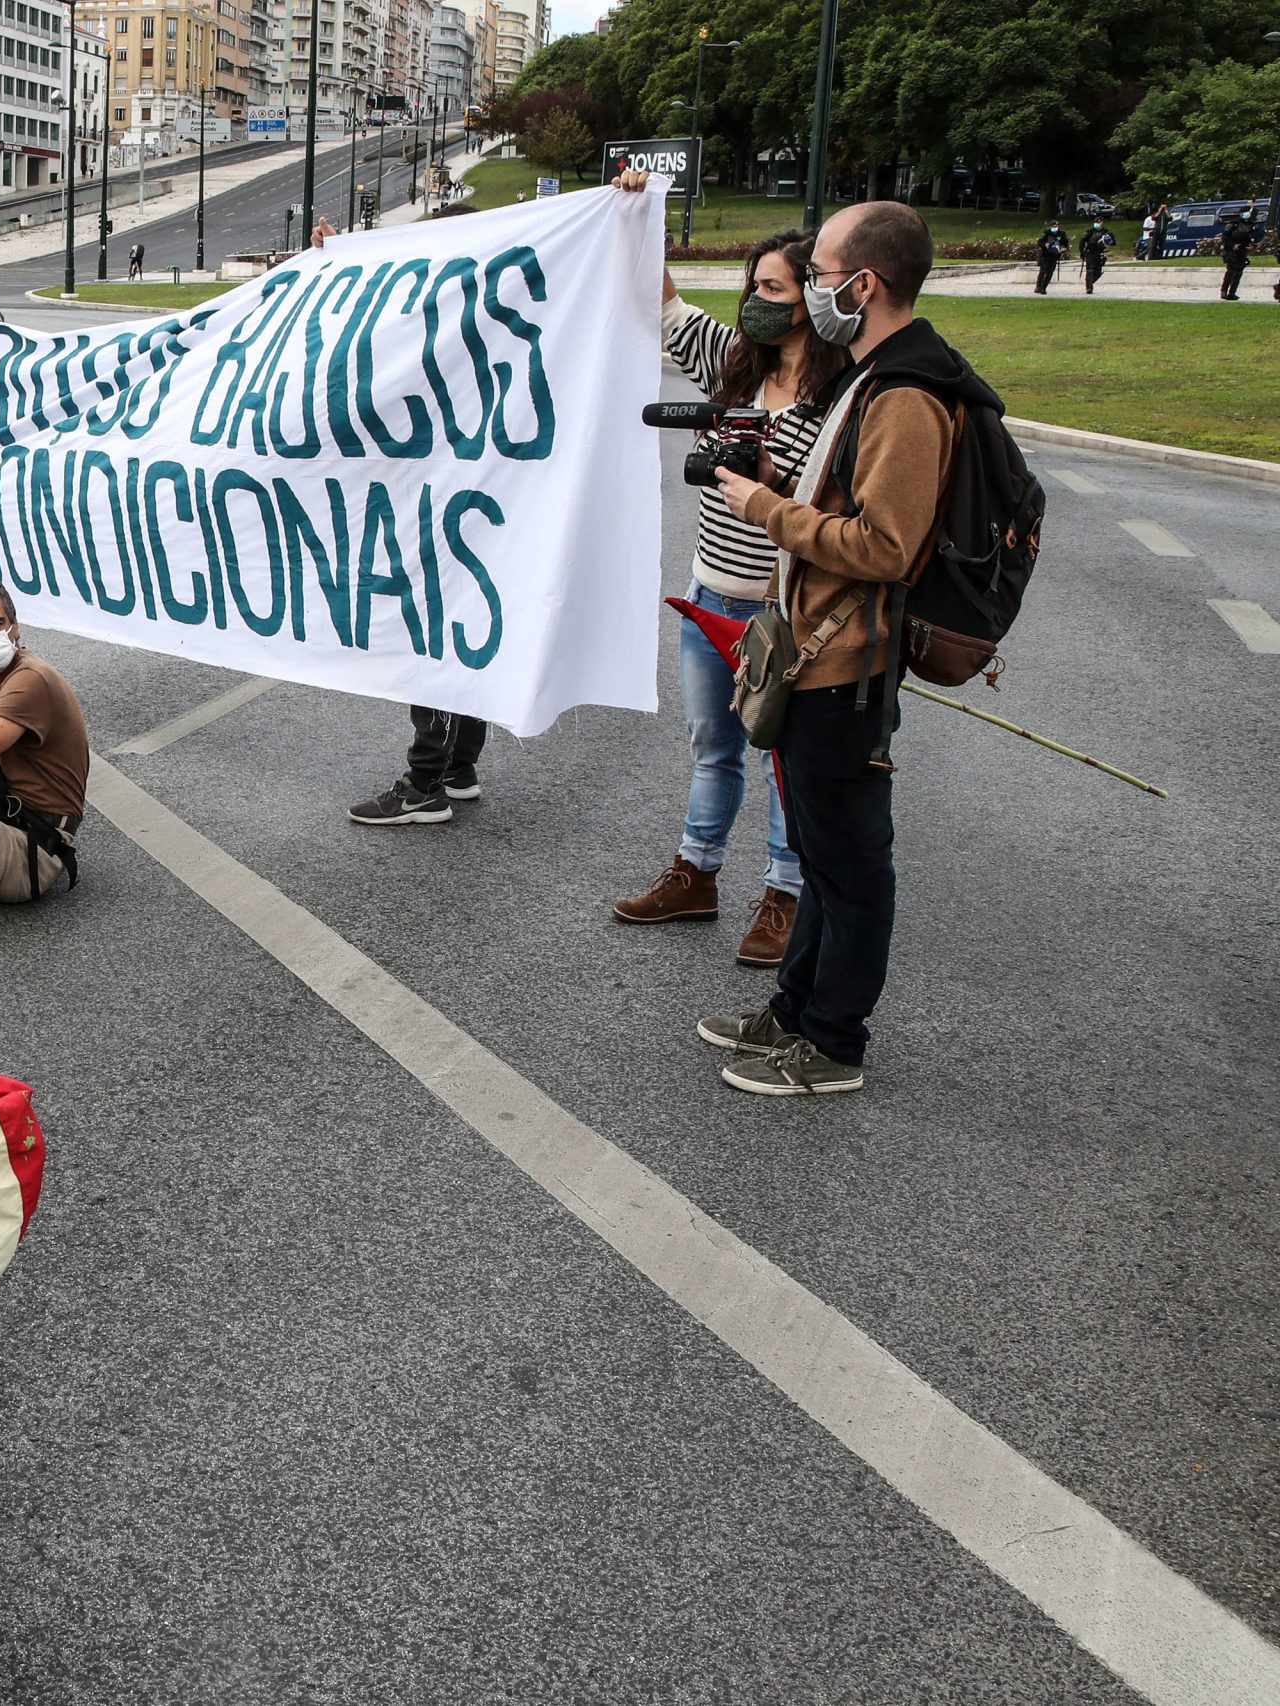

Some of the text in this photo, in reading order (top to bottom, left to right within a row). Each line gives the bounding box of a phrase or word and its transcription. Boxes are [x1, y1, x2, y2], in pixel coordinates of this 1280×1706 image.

[626, 151, 687, 173] JOVENS
[189, 245, 555, 461] BÁSICOS
[661, 405, 698, 417] RØDE
